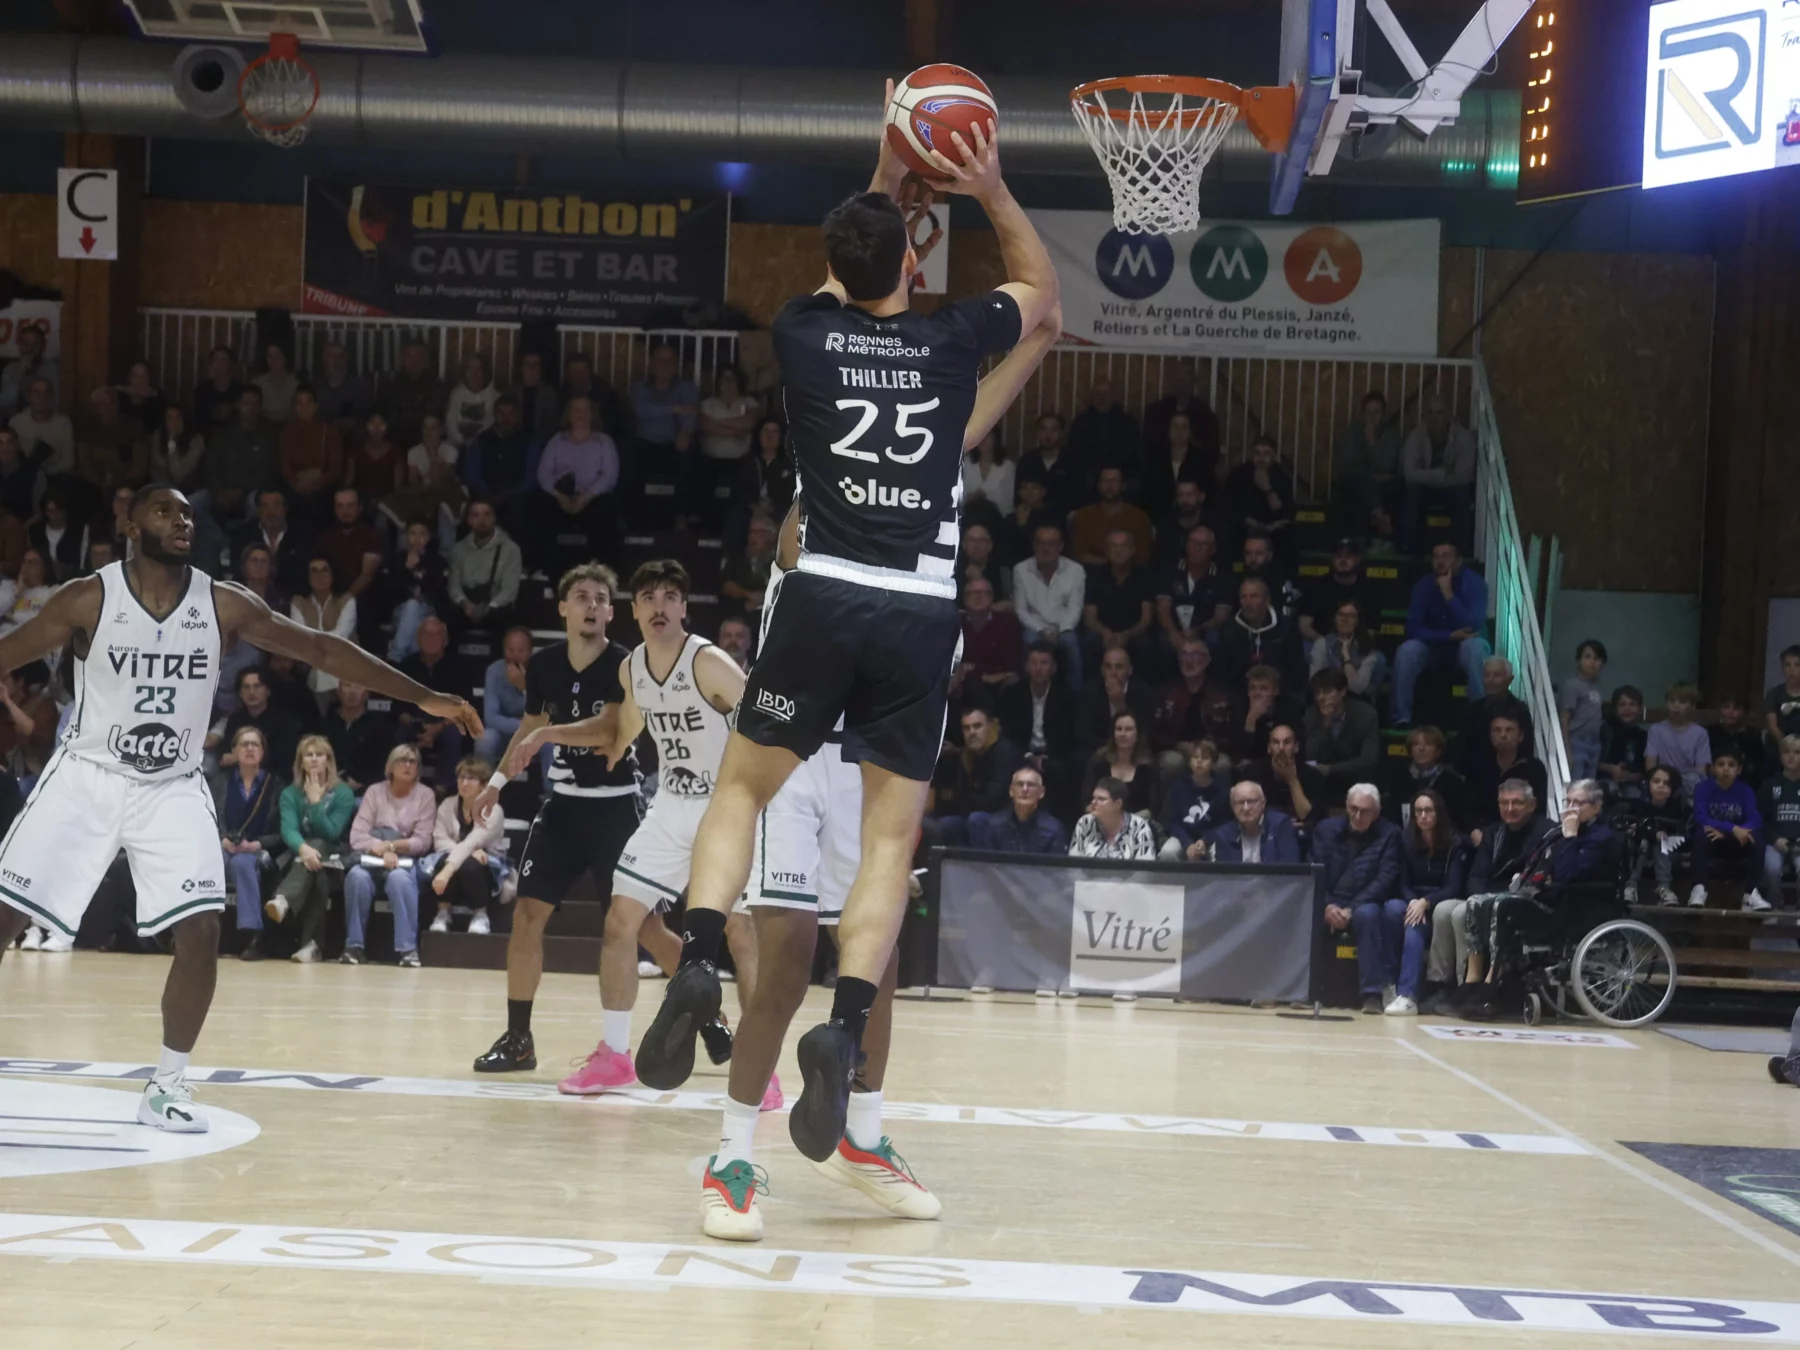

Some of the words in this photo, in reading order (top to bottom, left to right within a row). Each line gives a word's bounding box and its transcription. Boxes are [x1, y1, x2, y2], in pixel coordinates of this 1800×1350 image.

[67, 172, 108, 222] C
[411, 190, 692, 238] d'Anthon'
[410, 246, 518, 278] CAVE
[533, 250, 583, 279] ET
[597, 253, 679, 283] BAR
[419, 285, 432, 296] de
[1100, 302, 1142, 318] Vitré,
[1146, 304, 1214, 322] Argentré
[1219, 305, 1238, 319] du
[1242, 307, 1301, 323] Plessis,
[1305, 308, 1354, 324] Janzé,
[1093, 320, 1148, 336] Retiers
[1153, 322, 1168, 336] et
[1173, 323, 1190, 337] La
[1195, 324, 1258, 339] Guerche
[1263, 325, 1282, 339] de
[1286, 327, 1361, 343] Bretagne.
[838, 367, 923, 389] THILLIER
[830, 396, 940, 465] 25
[838, 476, 931, 510] blue.
[107, 644, 140, 653] Aurore
[134, 685, 176, 715] 23
[571, 700, 580, 717] 8
[107, 724, 191, 762] lactel
[661, 737, 691, 761] 26
[522, 859, 533, 877] 8
[198, 880, 216, 888] MSD
[1083, 910, 1171, 952] Vitré
[1121, 1269, 1782, 1334] MTB
